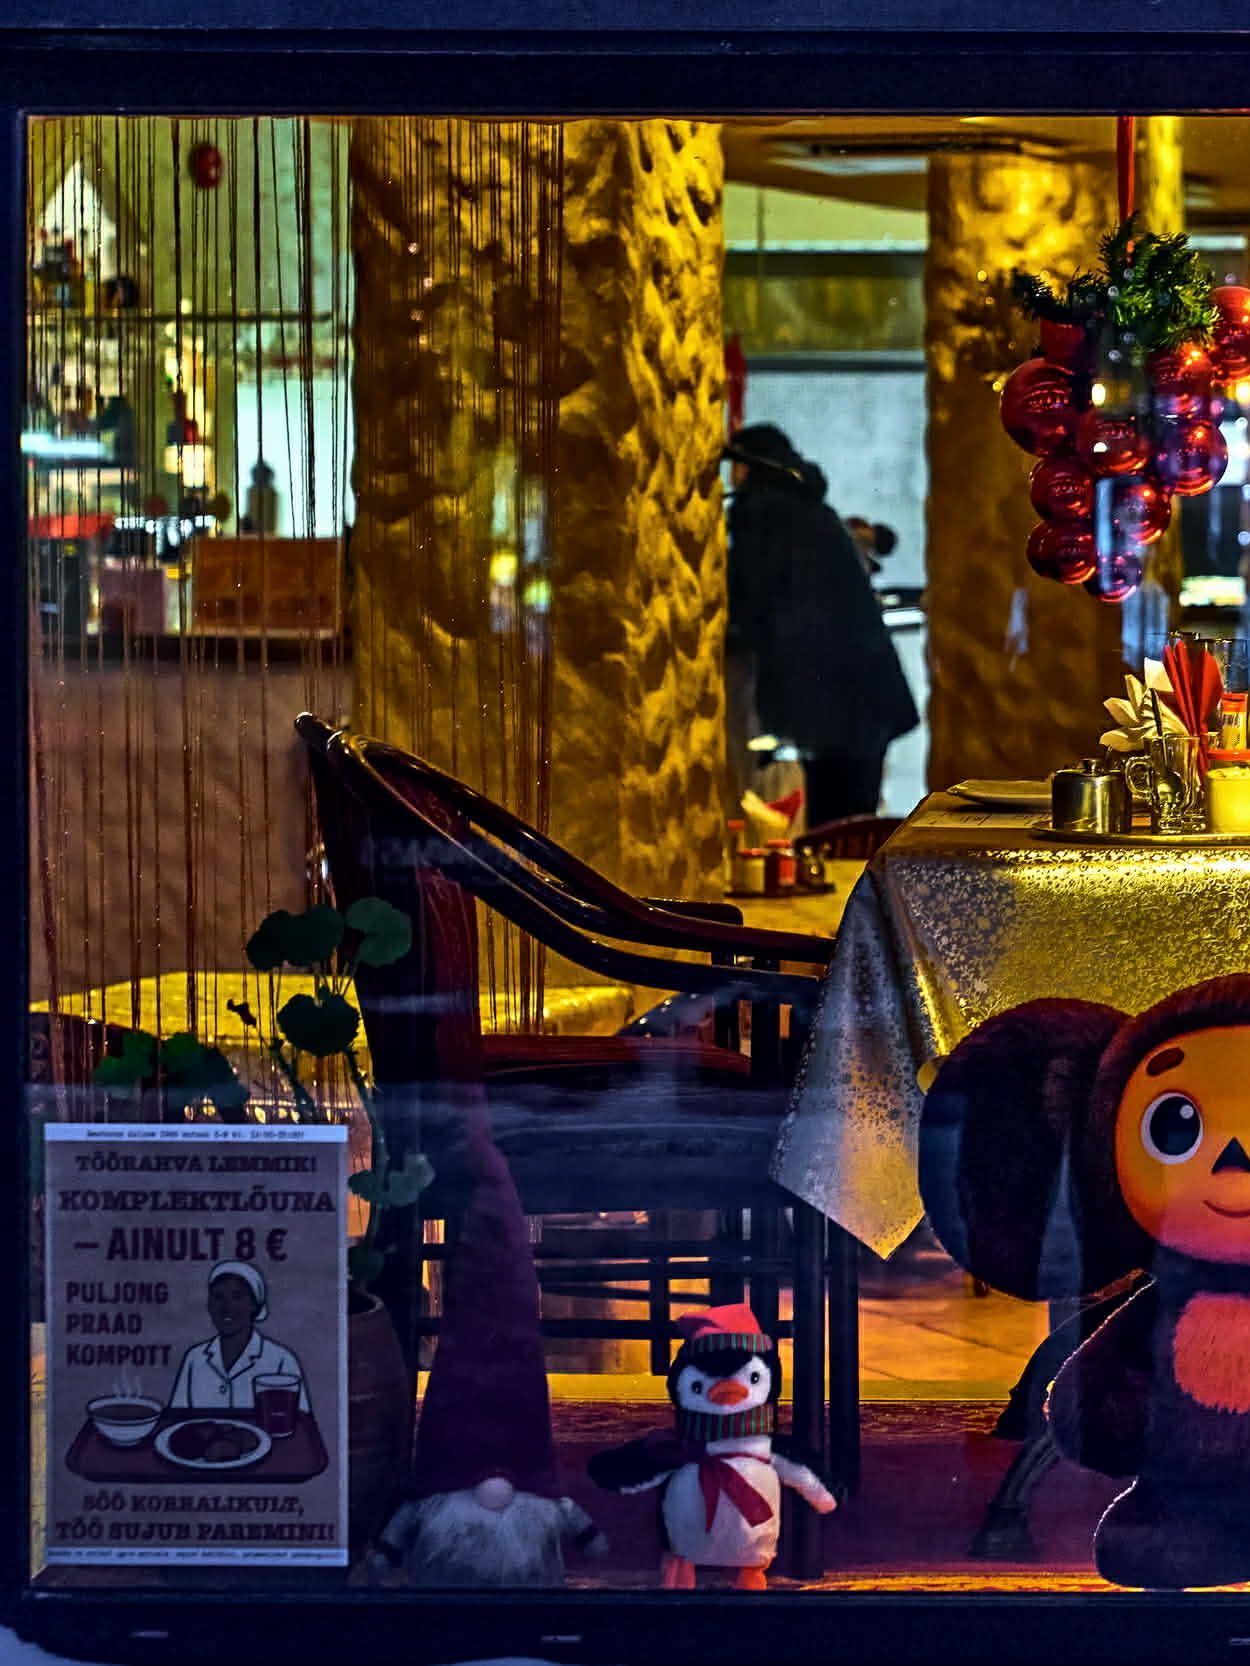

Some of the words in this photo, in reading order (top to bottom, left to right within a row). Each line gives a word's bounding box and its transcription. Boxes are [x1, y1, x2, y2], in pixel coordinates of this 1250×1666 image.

[208, 1155, 317, 1173] LEMMIK!
[58, 1184, 336, 1212] KOMPLEKTLÕUNA
[106, 1228, 225, 1261] AINULT
[235, 1228, 257, 1261] 8
[266, 1228, 288, 1262] €
[65, 1281, 168, 1305] PULJONG
[65, 1312, 143, 1335] PRAAD
[65, 1344, 172, 1367] KOMPOTT
[108, 1521, 191, 1541] SUJUB
[199, 1522, 335, 1542] PAREMINI!
